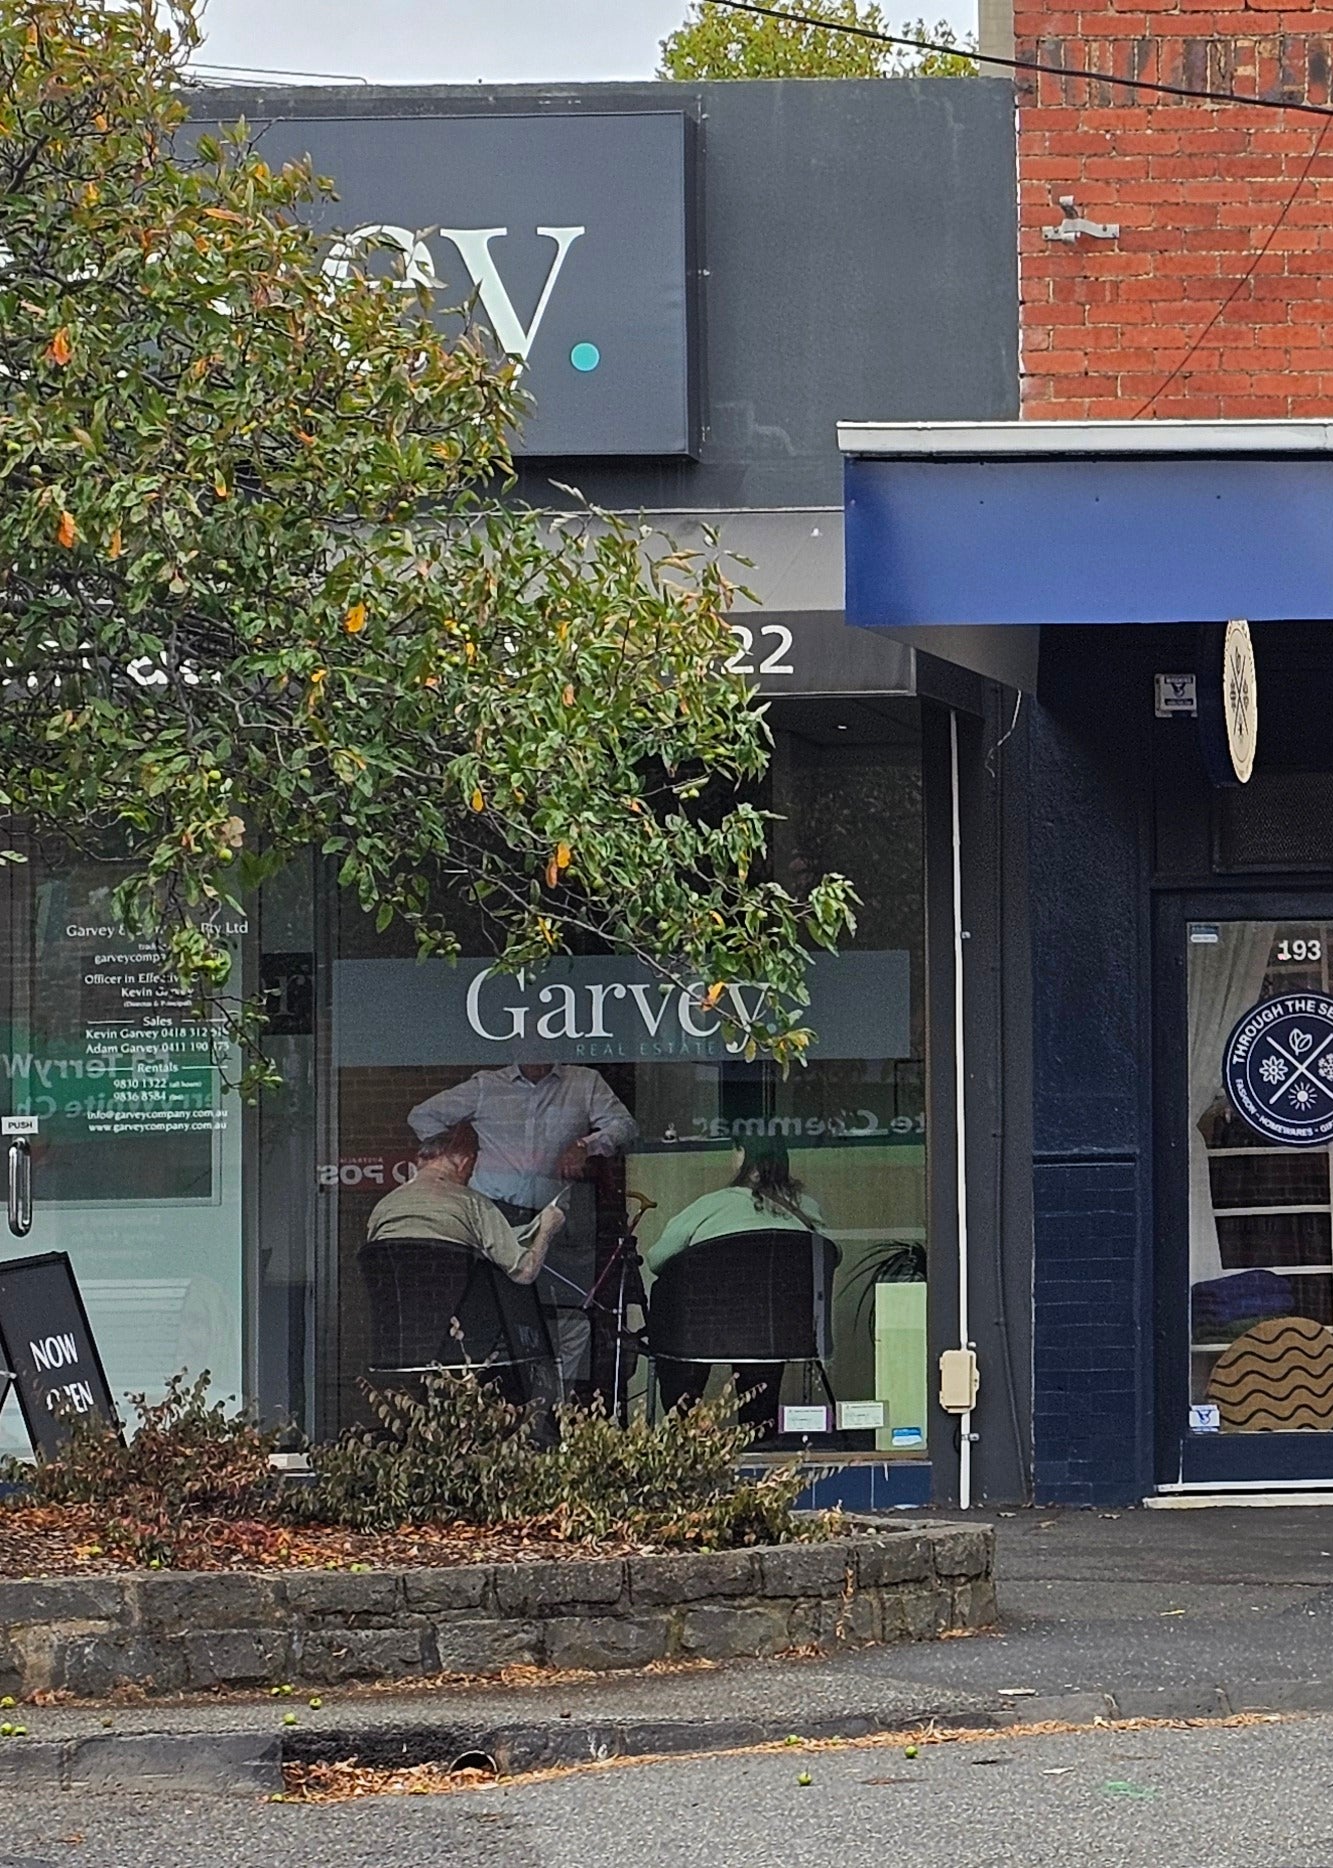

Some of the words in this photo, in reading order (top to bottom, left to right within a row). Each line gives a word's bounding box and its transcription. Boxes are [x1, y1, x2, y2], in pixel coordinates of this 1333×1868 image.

[66, 923, 116, 939] Garvey
[226, 921, 249, 934] Ltd
[1277, 939, 1322, 961] 193
[121, 987, 153, 998] Kevin
[142, 1016, 173, 1027] Sales
[85, 1028, 118, 1040] Kevin
[120, 1028, 159, 1040] Garvey
[161, 1027, 187, 1039] 0418
[1232, 1001, 1285, 1065] THROUGH
[1285, 998, 1317, 1014] THE
[85, 1043, 119, 1054] Adam
[120, 1042, 160, 1055] Garvey
[575, 1043, 624, 1057] REAL
[639, 1040, 716, 1056] ESTATE
[137, 1062, 179, 1073] Rentals
[113, 1079, 138, 1089] 9830
[141, 1078, 168, 1088] 1322
[8, 1121, 33, 1130] PUSH
[29, 1332, 79, 1373] NOW
